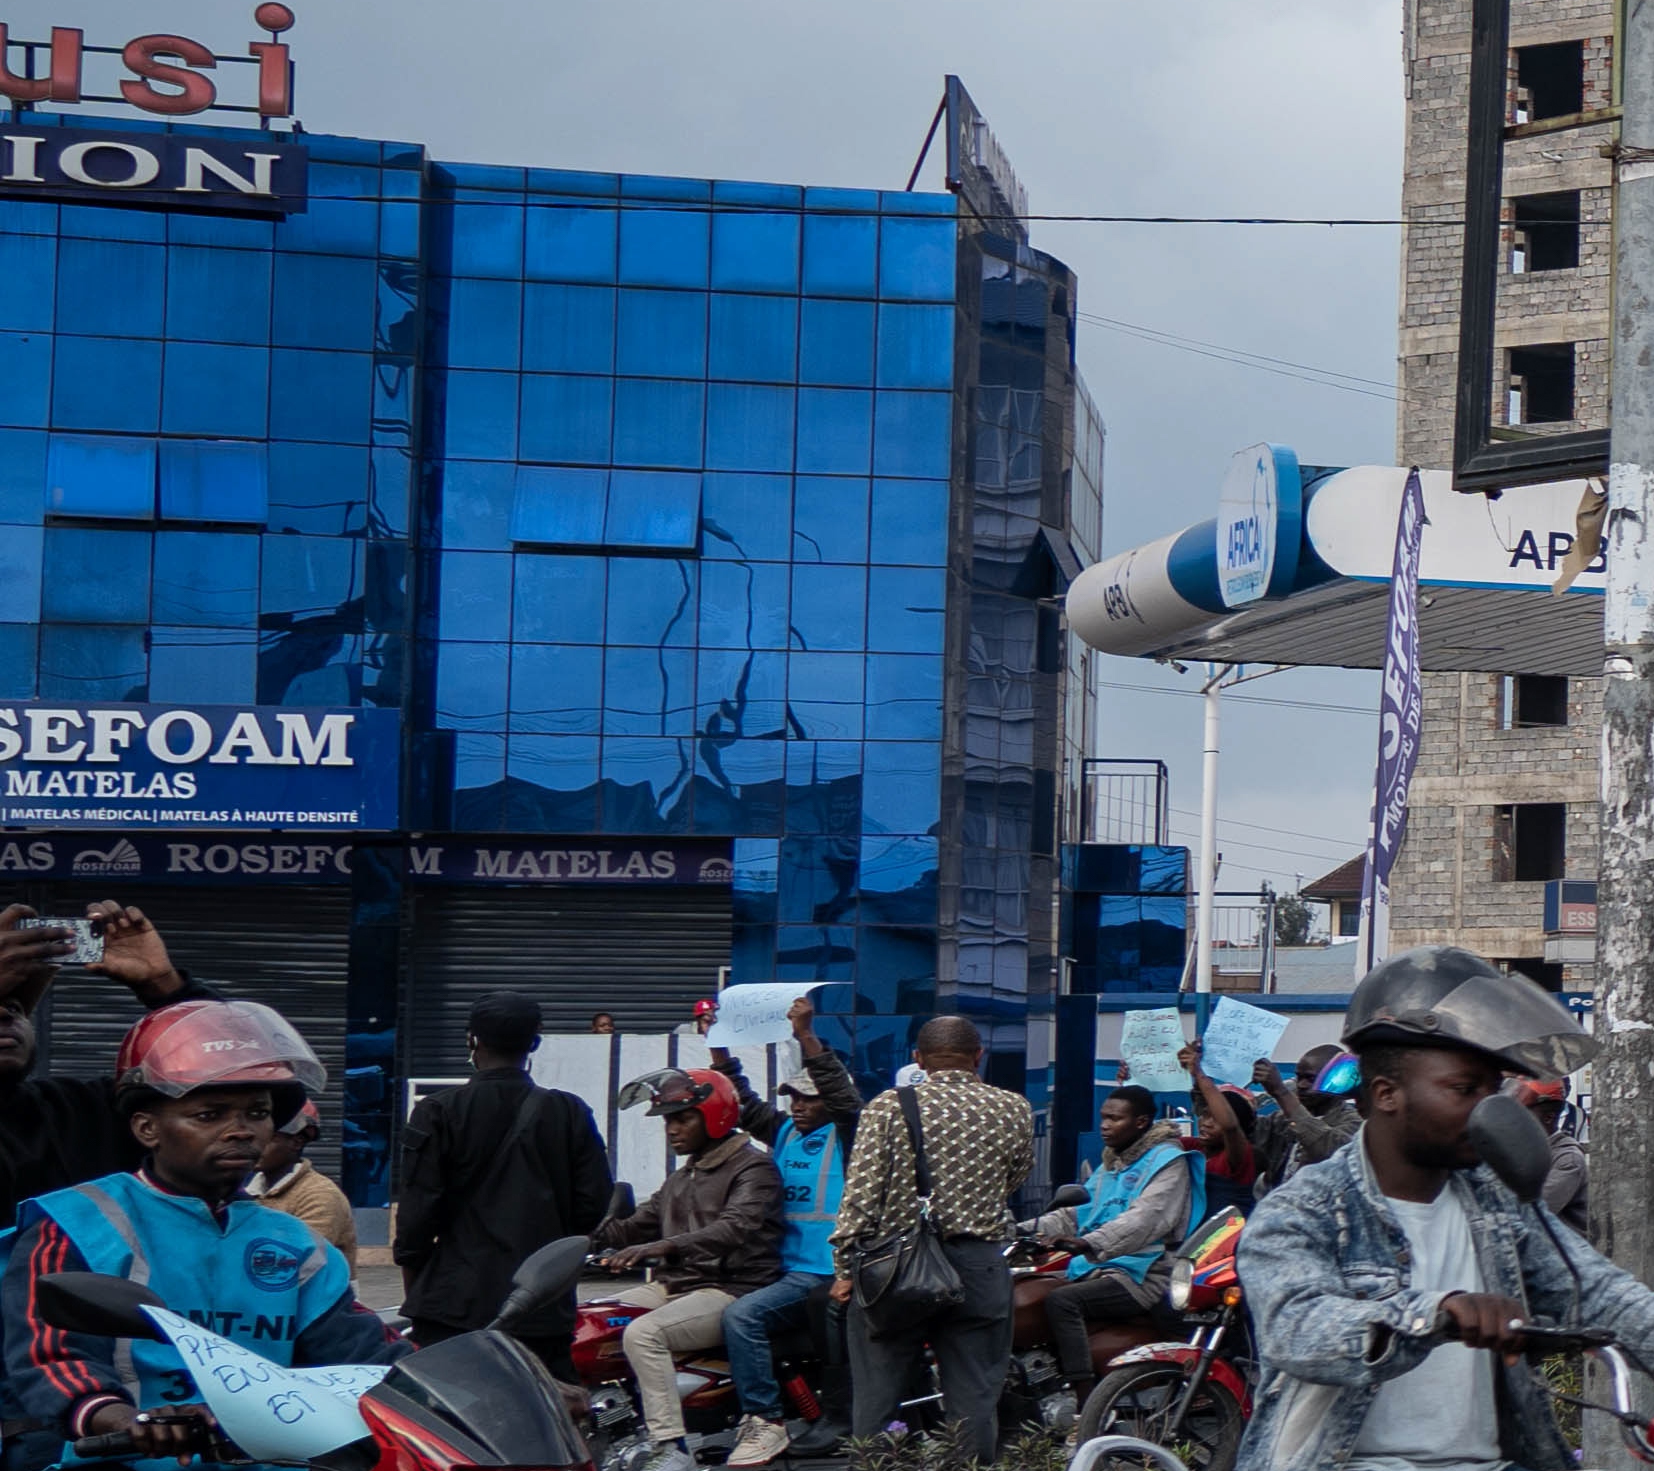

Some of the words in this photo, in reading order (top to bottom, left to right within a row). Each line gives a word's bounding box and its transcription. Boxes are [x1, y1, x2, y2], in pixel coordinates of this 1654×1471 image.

[2, 134, 282, 195] ION
[1227, 516, 1262, 570] AFRICA
[1104, 584, 1129, 621] APB
[5, 770, 197, 799] MATELAS
[11, 808, 81, 820] MATELAS
[160, 810, 229, 822] MATELAS
[232, 808, 242, 822] À
[246, 811, 294, 823] HAUTE
[297, 809, 358, 823] DENSITÉ
[73, 863, 140, 871] ROSEFOAM
[473, 850, 676, 878] MATELAS
[1567, 911, 1597, 927] ESS
[201, 1039, 234, 1053] TVS
[606, 1316, 631, 1327] TVS
